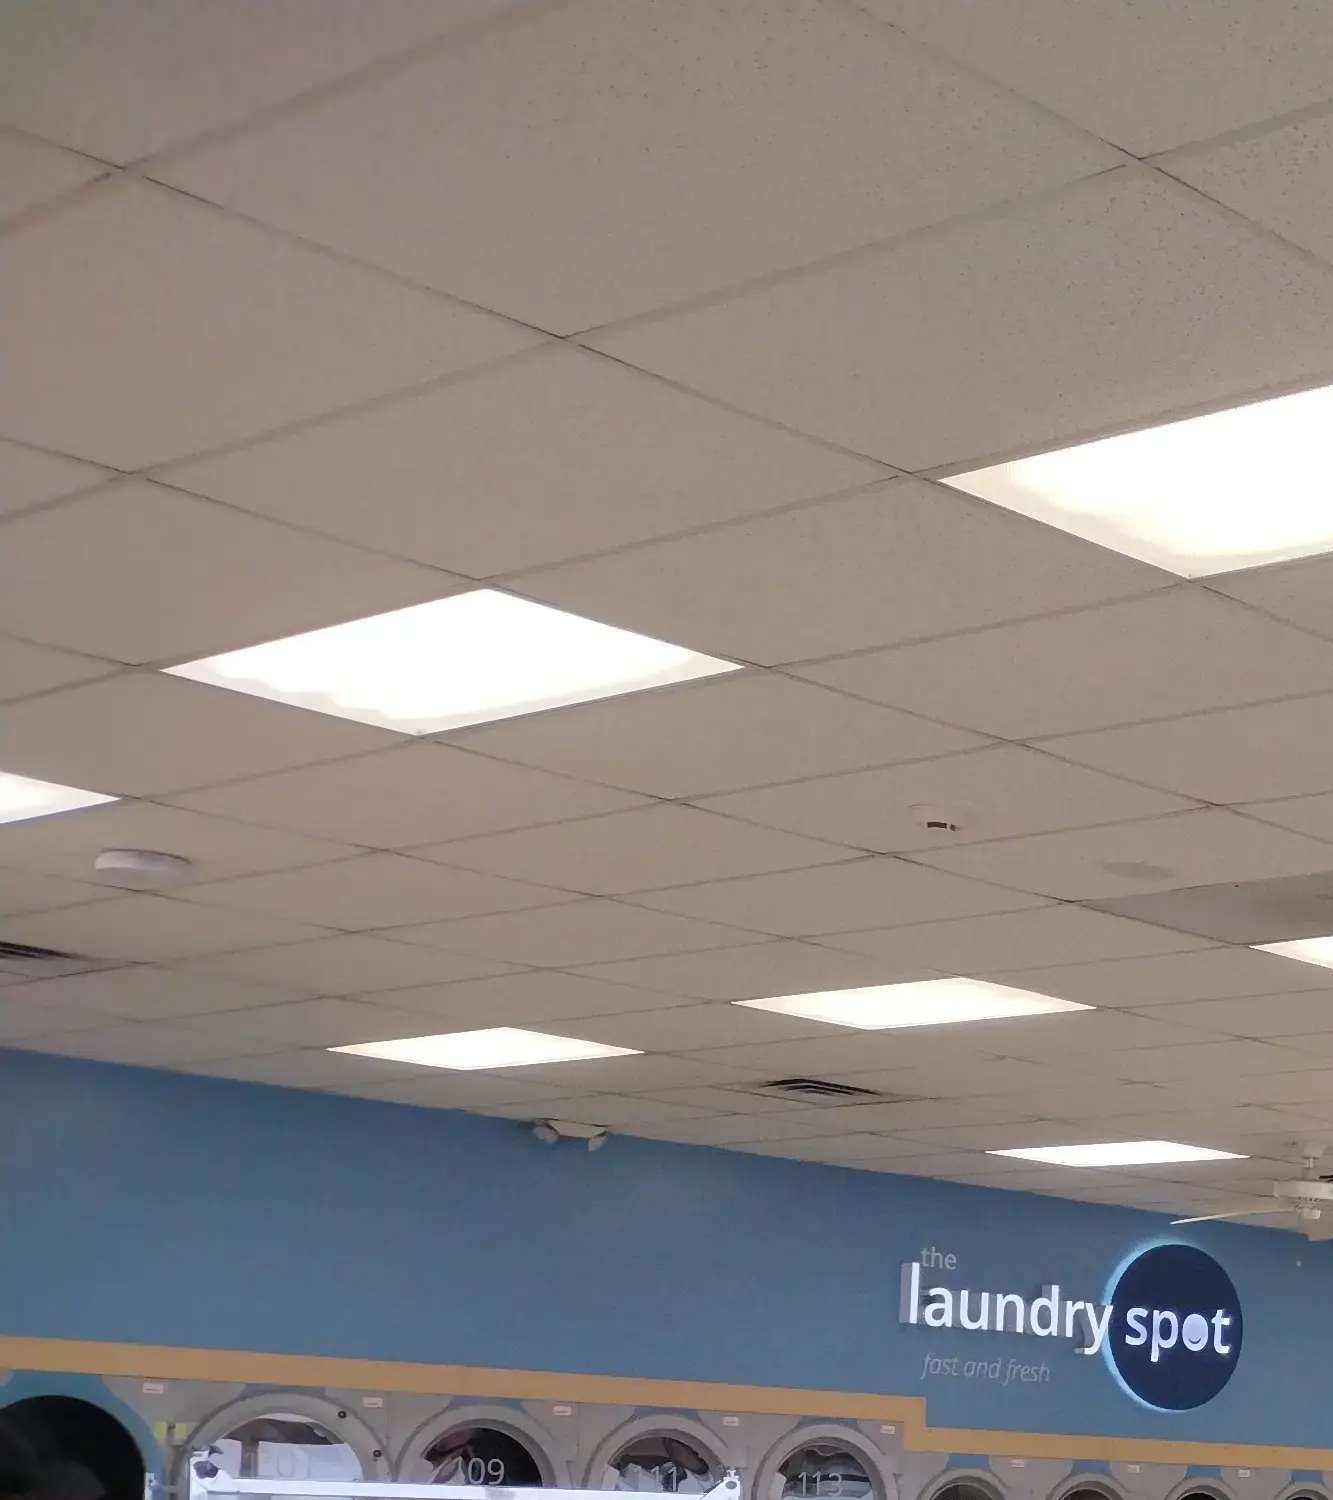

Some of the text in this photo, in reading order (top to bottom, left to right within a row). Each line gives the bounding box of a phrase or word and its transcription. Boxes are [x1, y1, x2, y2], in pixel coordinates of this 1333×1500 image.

[921, 1246, 957, 1270] the
[907, 1261, 1232, 1363] laundry spot
[919, 1351, 1051, 1386] fast and fresh
[798, 1470, 842, 1497] 113
